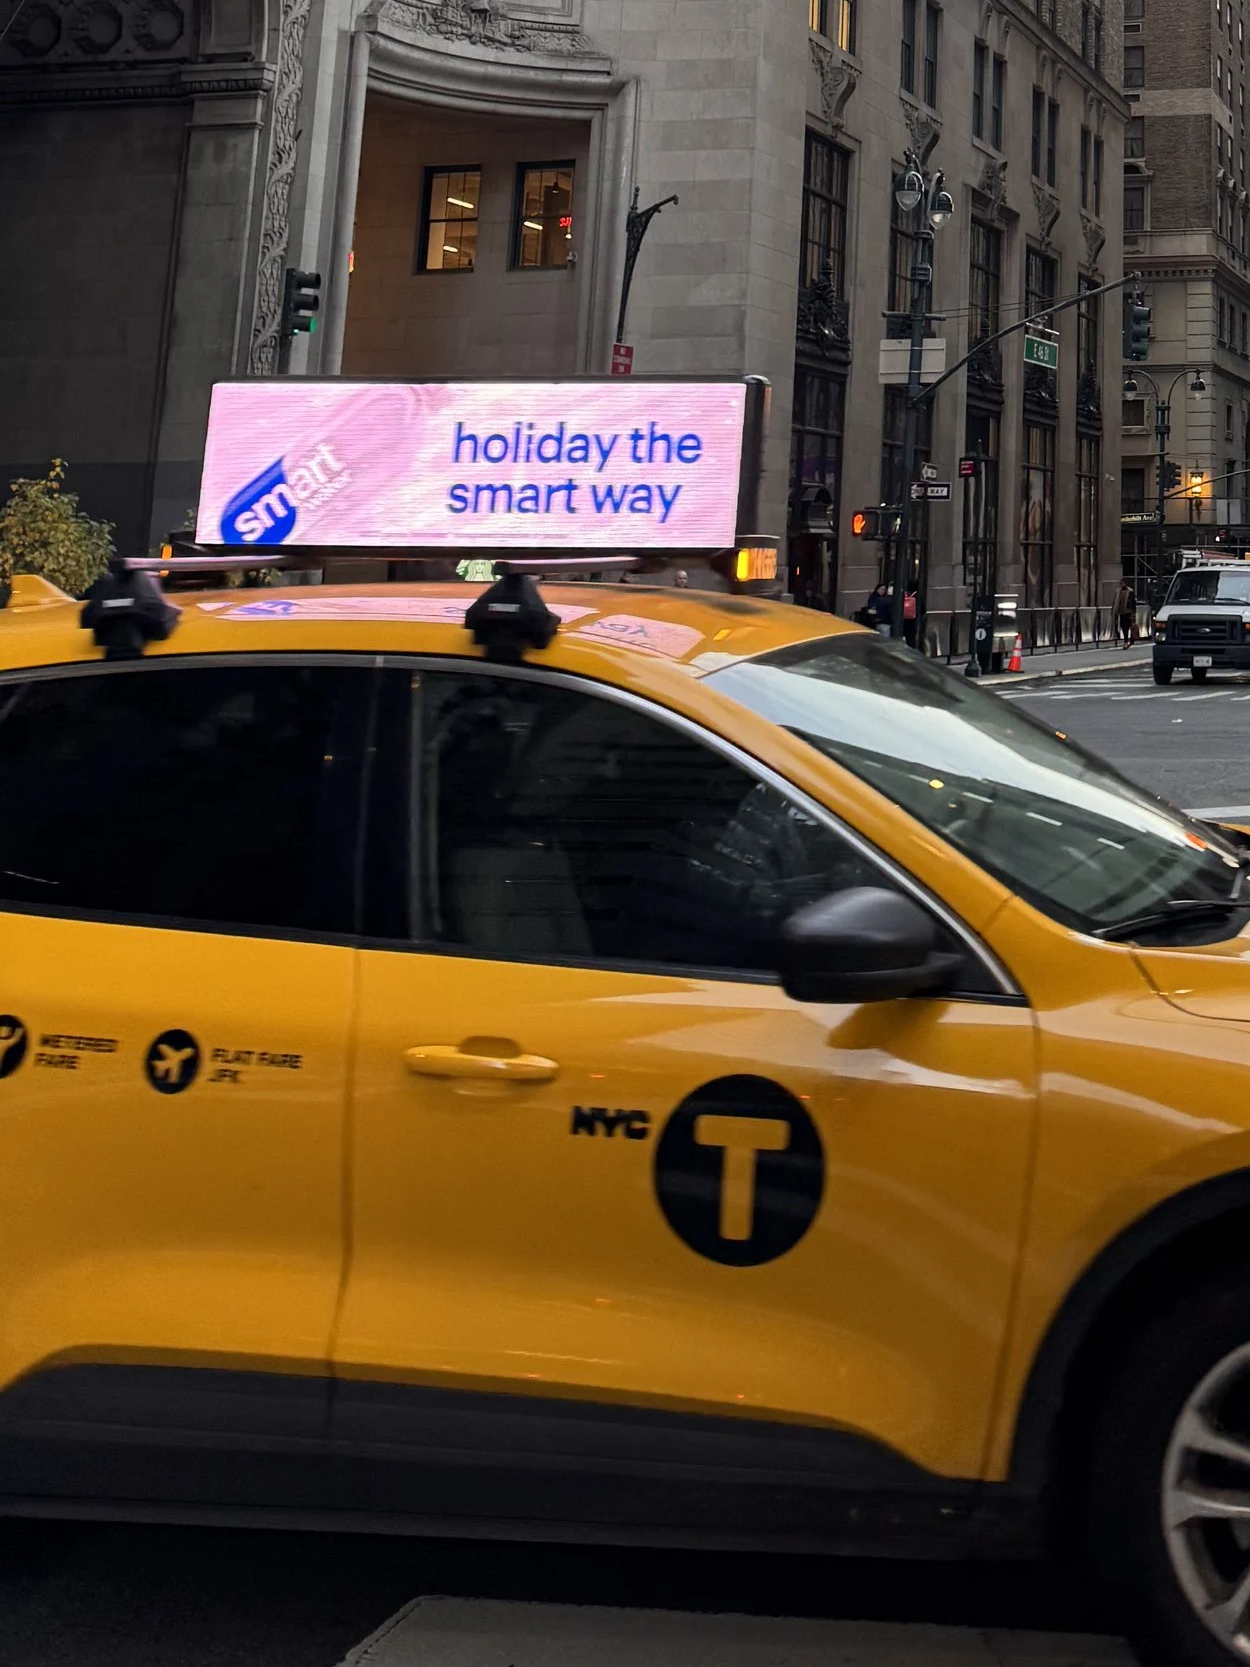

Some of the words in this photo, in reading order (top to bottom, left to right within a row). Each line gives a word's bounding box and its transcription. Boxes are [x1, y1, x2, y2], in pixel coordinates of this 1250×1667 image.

[453, 420, 619, 473] holiday
[630, 420, 703, 464] the
[234, 441, 345, 542] smart
[447, 478, 579, 515] smart
[591, 482, 683, 524] way
[35, 1052, 81, 1070] FARE
[211, 1048, 255, 1065] FLAT
[257, 1052, 304, 1070] FARE
[571, 1105, 651, 1140] NYC
[693, 1113, 792, 1241] T
